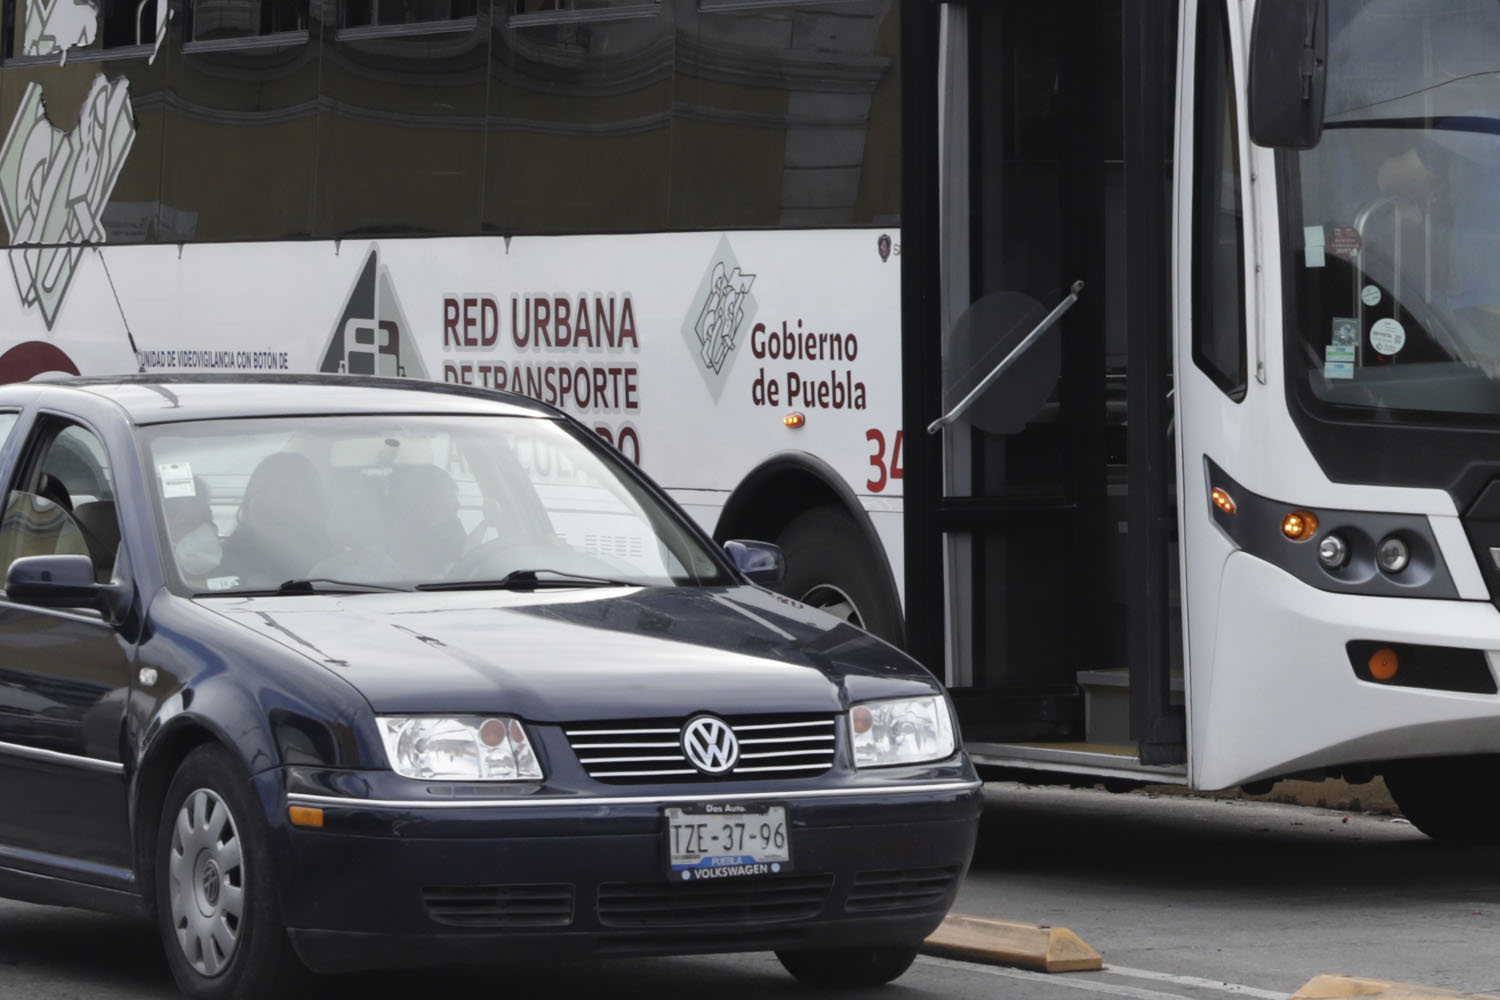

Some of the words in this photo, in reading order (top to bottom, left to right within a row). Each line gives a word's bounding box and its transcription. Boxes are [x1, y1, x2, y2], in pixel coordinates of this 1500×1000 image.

[443, 297, 499, 347] RED
[511, 297, 640, 349] URBANA
[751, 318, 858, 362] Gobierno
[139, 350, 165, 368] UNIDAD
[167, 350, 176, 368] DE
[177, 350, 235, 369] VIDEOVIGILANCIA
[237, 351, 252, 369] CON
[279, 351, 289, 370] DE
[478, 365, 639, 409] TRANSPORTE
[752, 367, 779, 407] de
[787, 369, 867, 411] Puebla
[706, 804, 722, 813] Das
[671, 822, 786, 854] TZE-37-96
[694, 864, 769, 879] VOLKSWAGEN
